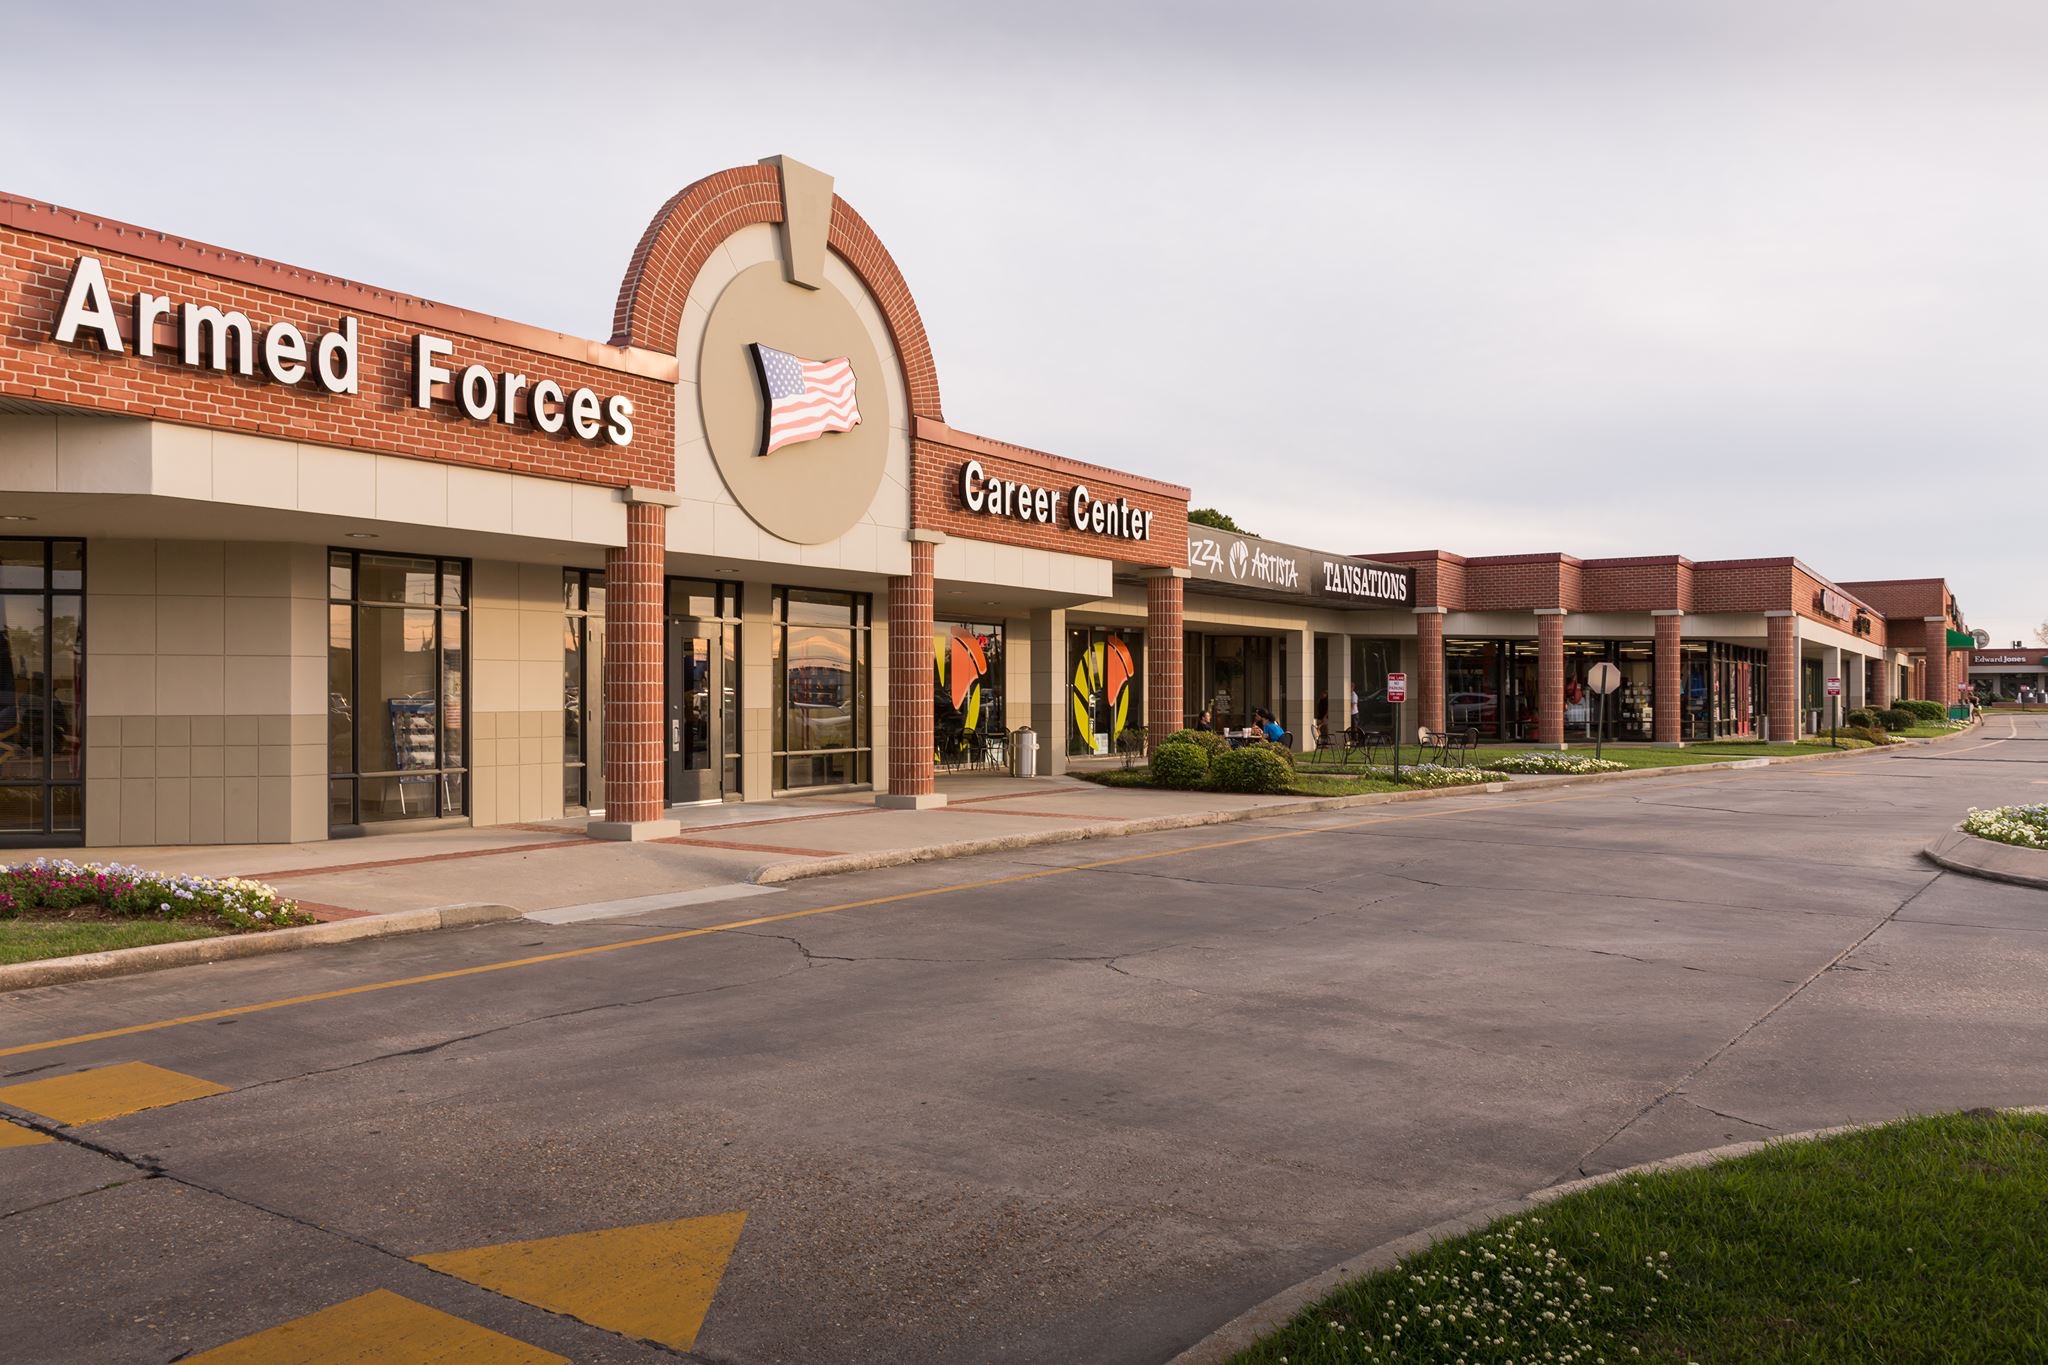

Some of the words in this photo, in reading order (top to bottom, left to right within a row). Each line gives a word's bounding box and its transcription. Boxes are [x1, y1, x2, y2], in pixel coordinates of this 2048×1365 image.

[53, 255, 359, 394] Armed
[412, 334, 634, 446] Forces
[960, 460, 1060, 524] Career
[1069, 485, 1153, 541] Center
[1251, 546, 1299, 588] ARTISTA
[1323, 561, 1407, 601] TANSATIONS
[1974, 655, 2002, 663] Edward
[2003, 655, 2026, 664] Jones
